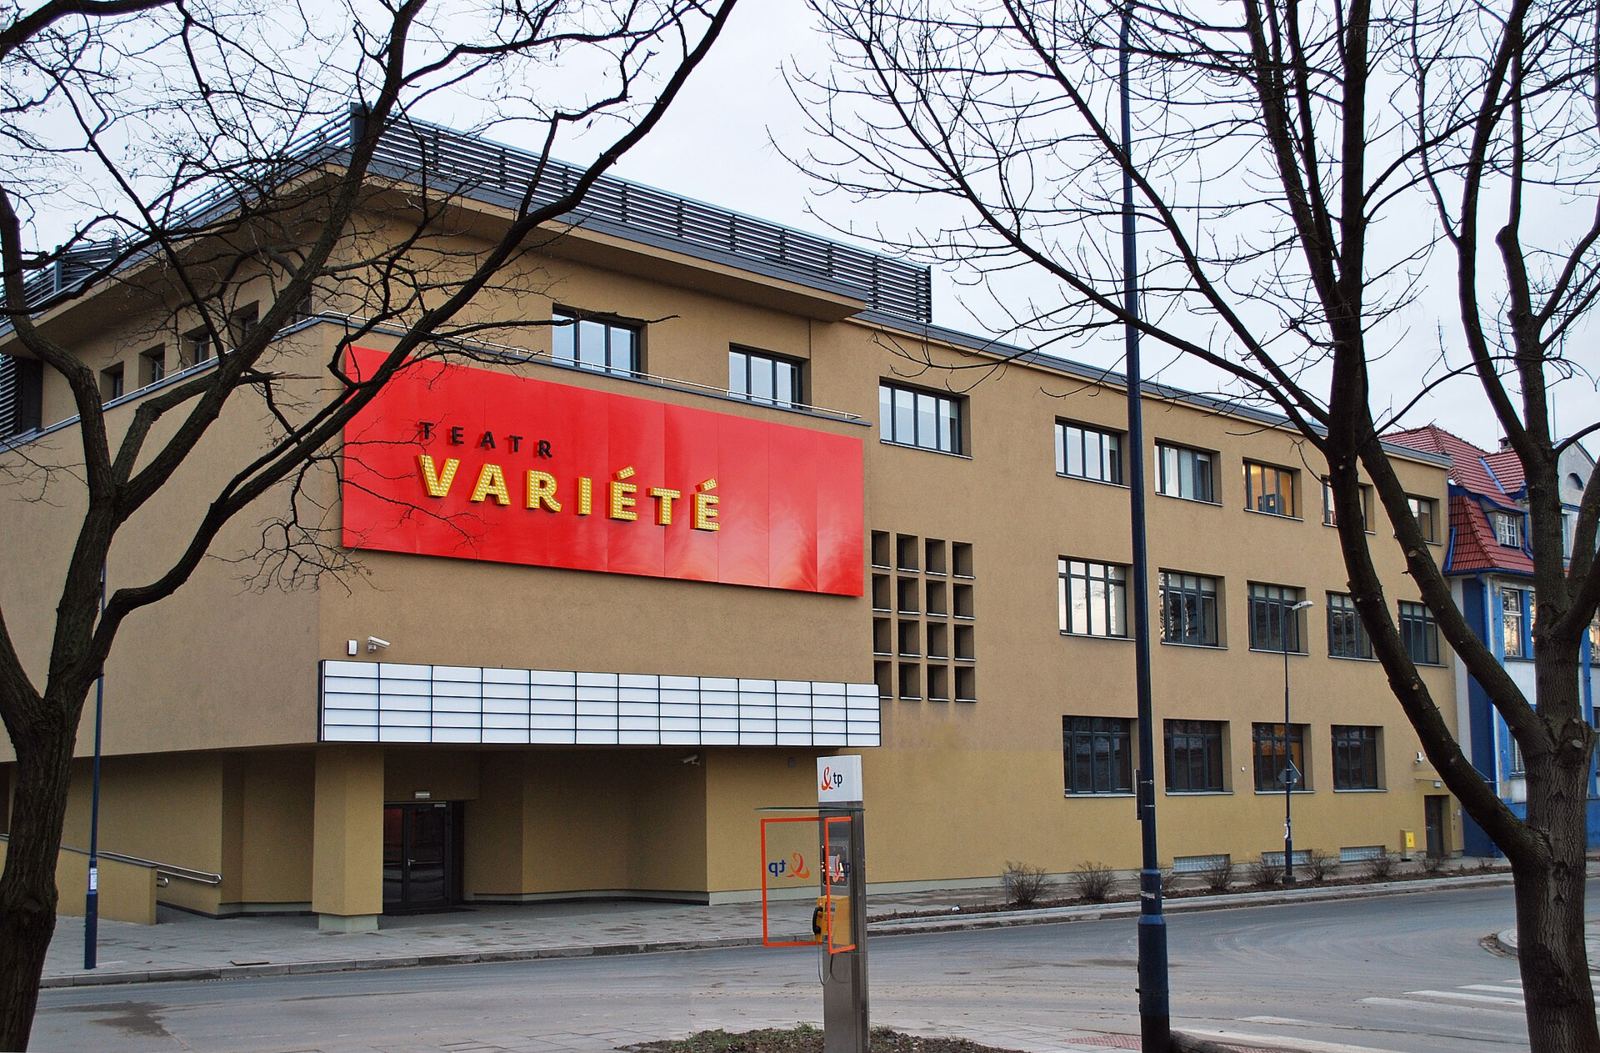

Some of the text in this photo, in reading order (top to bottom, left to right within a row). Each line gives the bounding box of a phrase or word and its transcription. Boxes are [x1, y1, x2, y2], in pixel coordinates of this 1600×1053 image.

[419, 421, 553, 458] TEATR
[417, 454, 720, 532] VARIÉTÉ
[833, 772, 843, 788] tp
